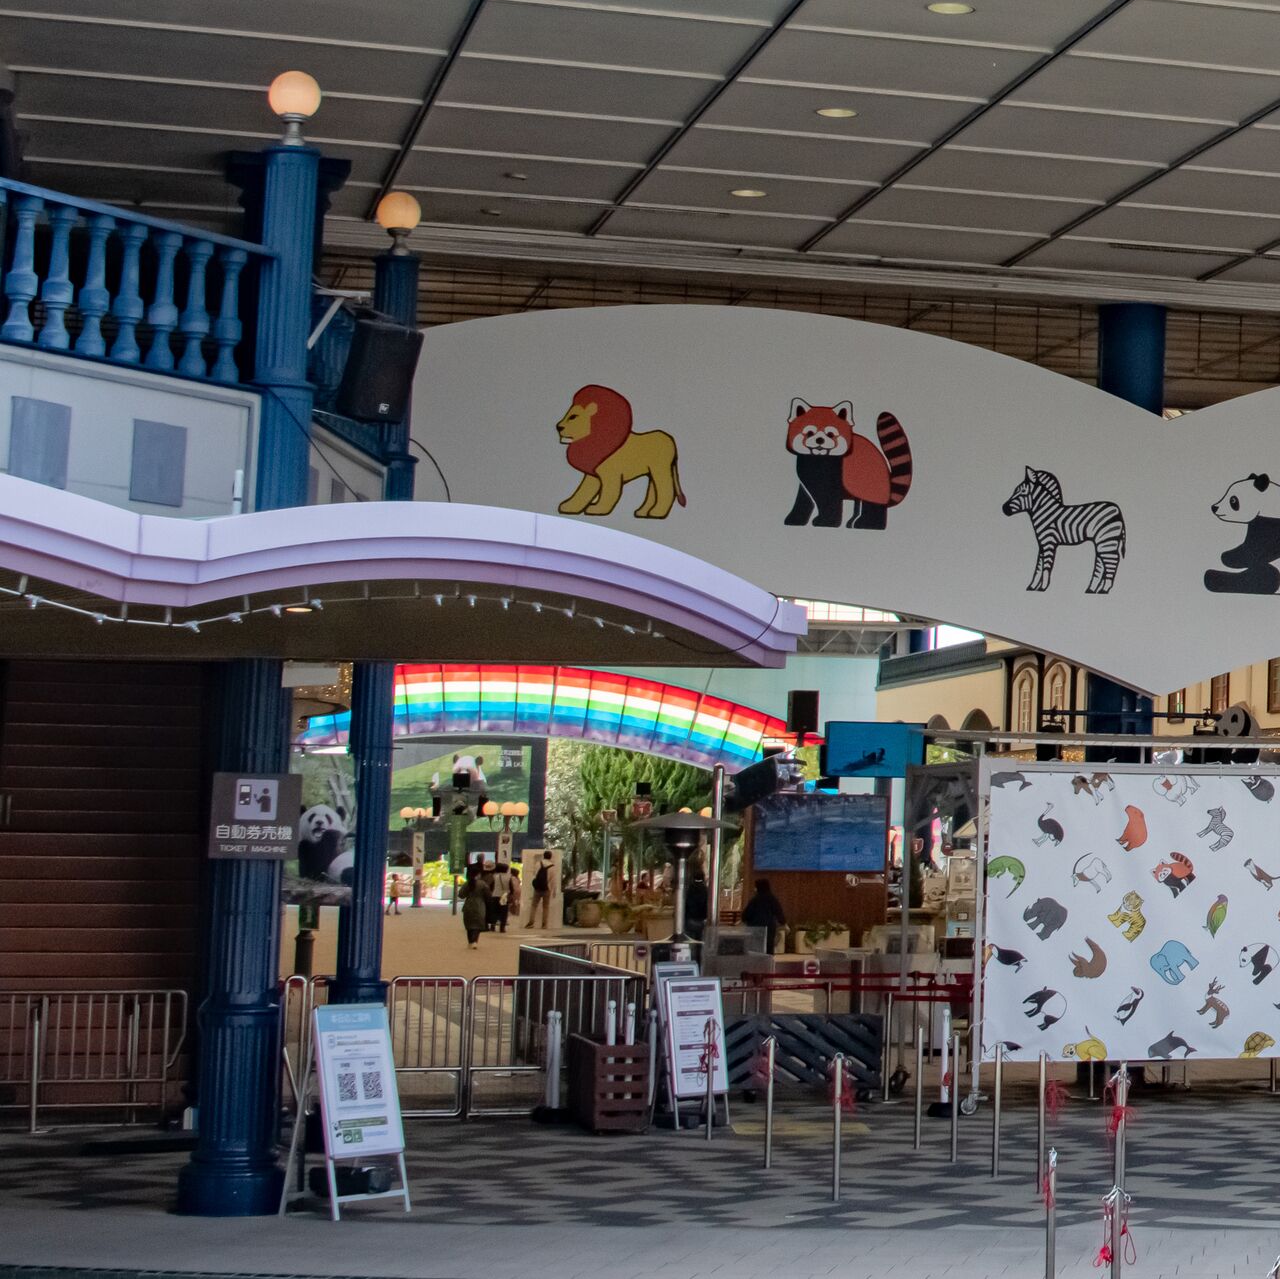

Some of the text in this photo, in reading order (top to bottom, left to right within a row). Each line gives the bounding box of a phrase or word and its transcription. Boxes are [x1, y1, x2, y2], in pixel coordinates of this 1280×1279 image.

[215, 824, 293, 840] 自動券売機
[220, 844, 248, 852] TICKET
